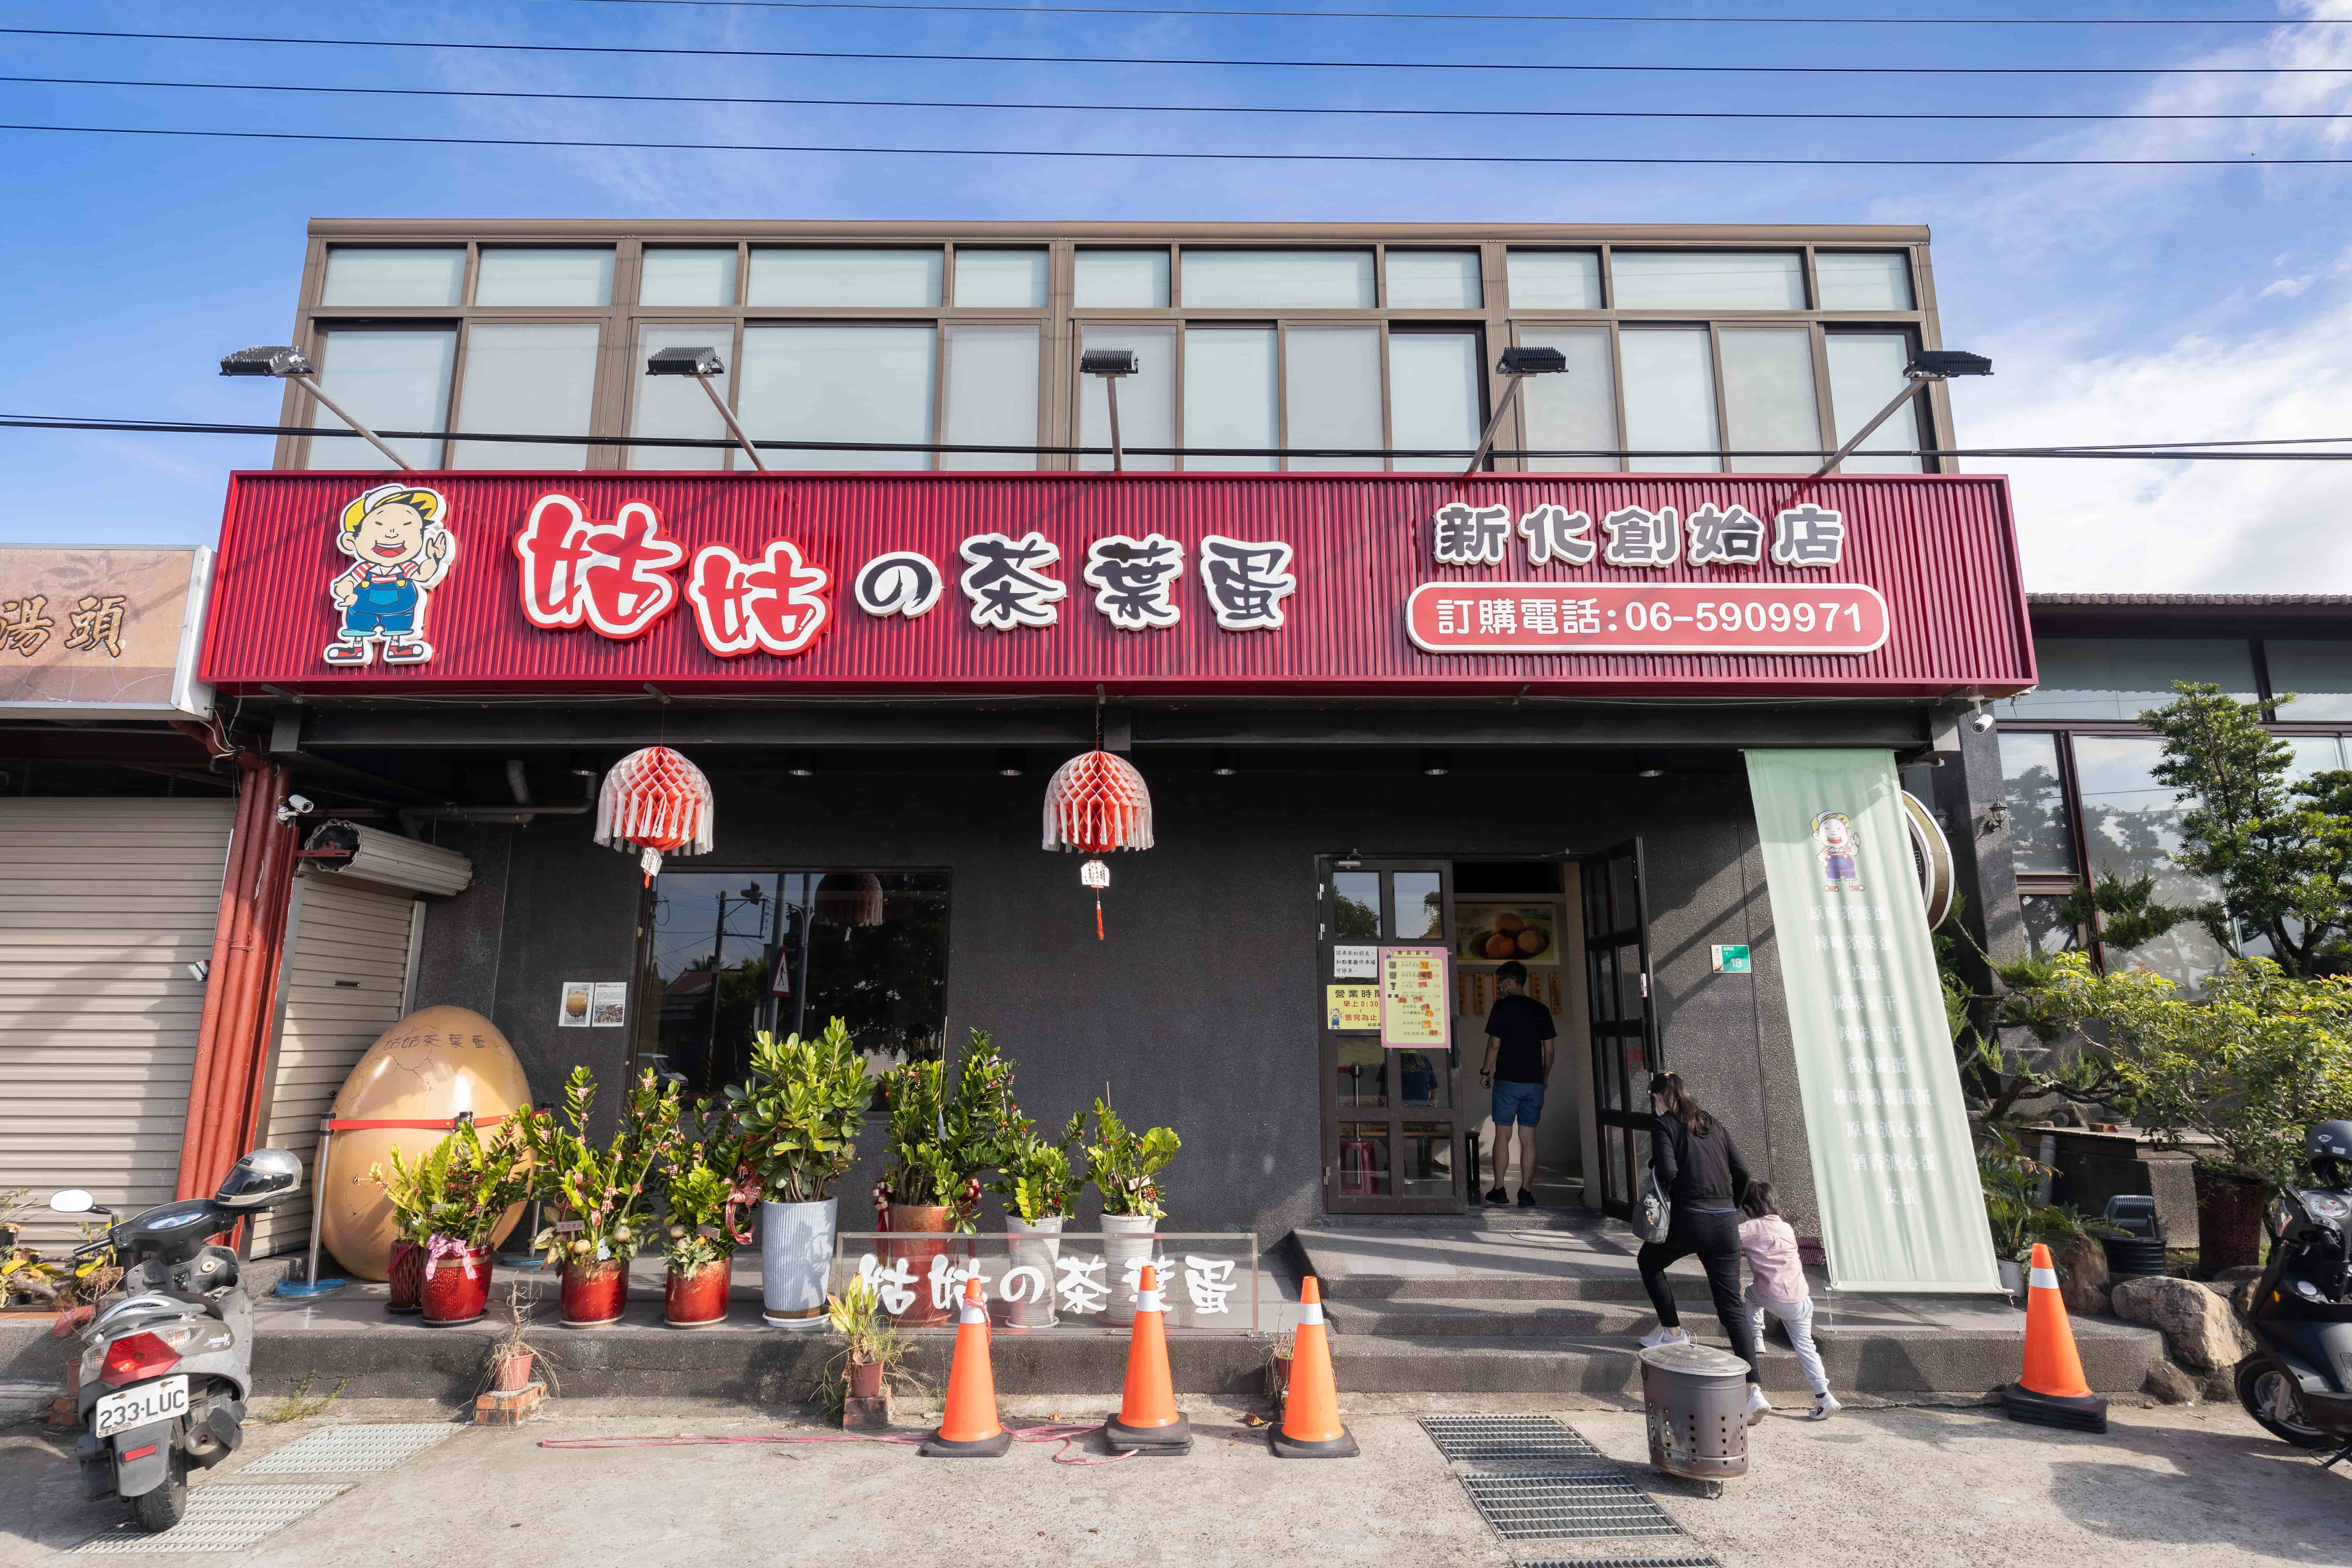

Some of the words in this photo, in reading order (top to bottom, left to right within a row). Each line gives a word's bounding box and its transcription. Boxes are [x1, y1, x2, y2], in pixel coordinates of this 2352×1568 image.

[1435, 503, 1844, 568] 新化創始店
[1809, 905, 1888, 921] 原味茶葉蛋
[1730, 958, 1742, 967] 18
[1833, 994, 1896, 1012] 原味豆干
[383, 1034, 488, 1050] 姑姑茶葉蛋
[1838, 1025, 1903, 1042] 辣味豆干
[1885, 1187, 1917, 1205] 皮蛋
